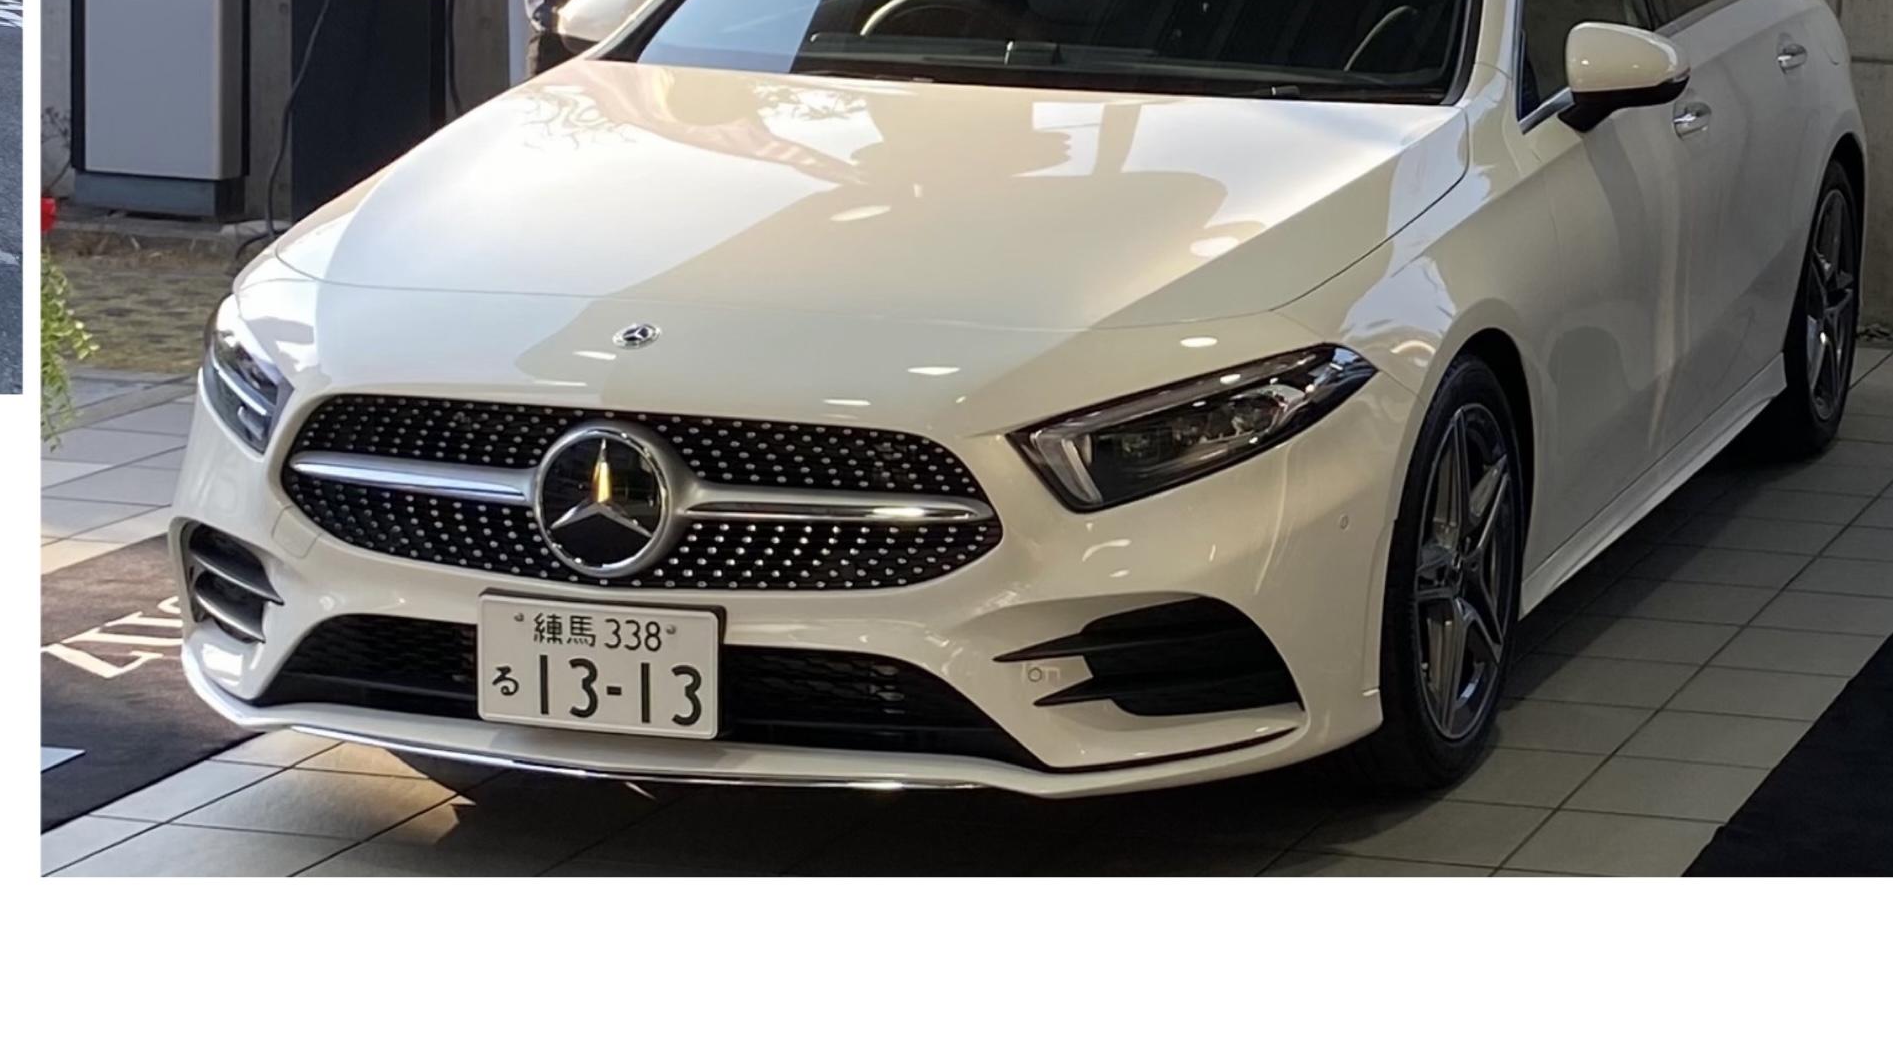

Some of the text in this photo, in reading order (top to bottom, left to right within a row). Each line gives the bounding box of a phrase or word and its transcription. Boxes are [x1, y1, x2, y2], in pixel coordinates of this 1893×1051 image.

[533, 612, 663, 652] 練馬 338
[492, 654, 702, 727] る 13-13
